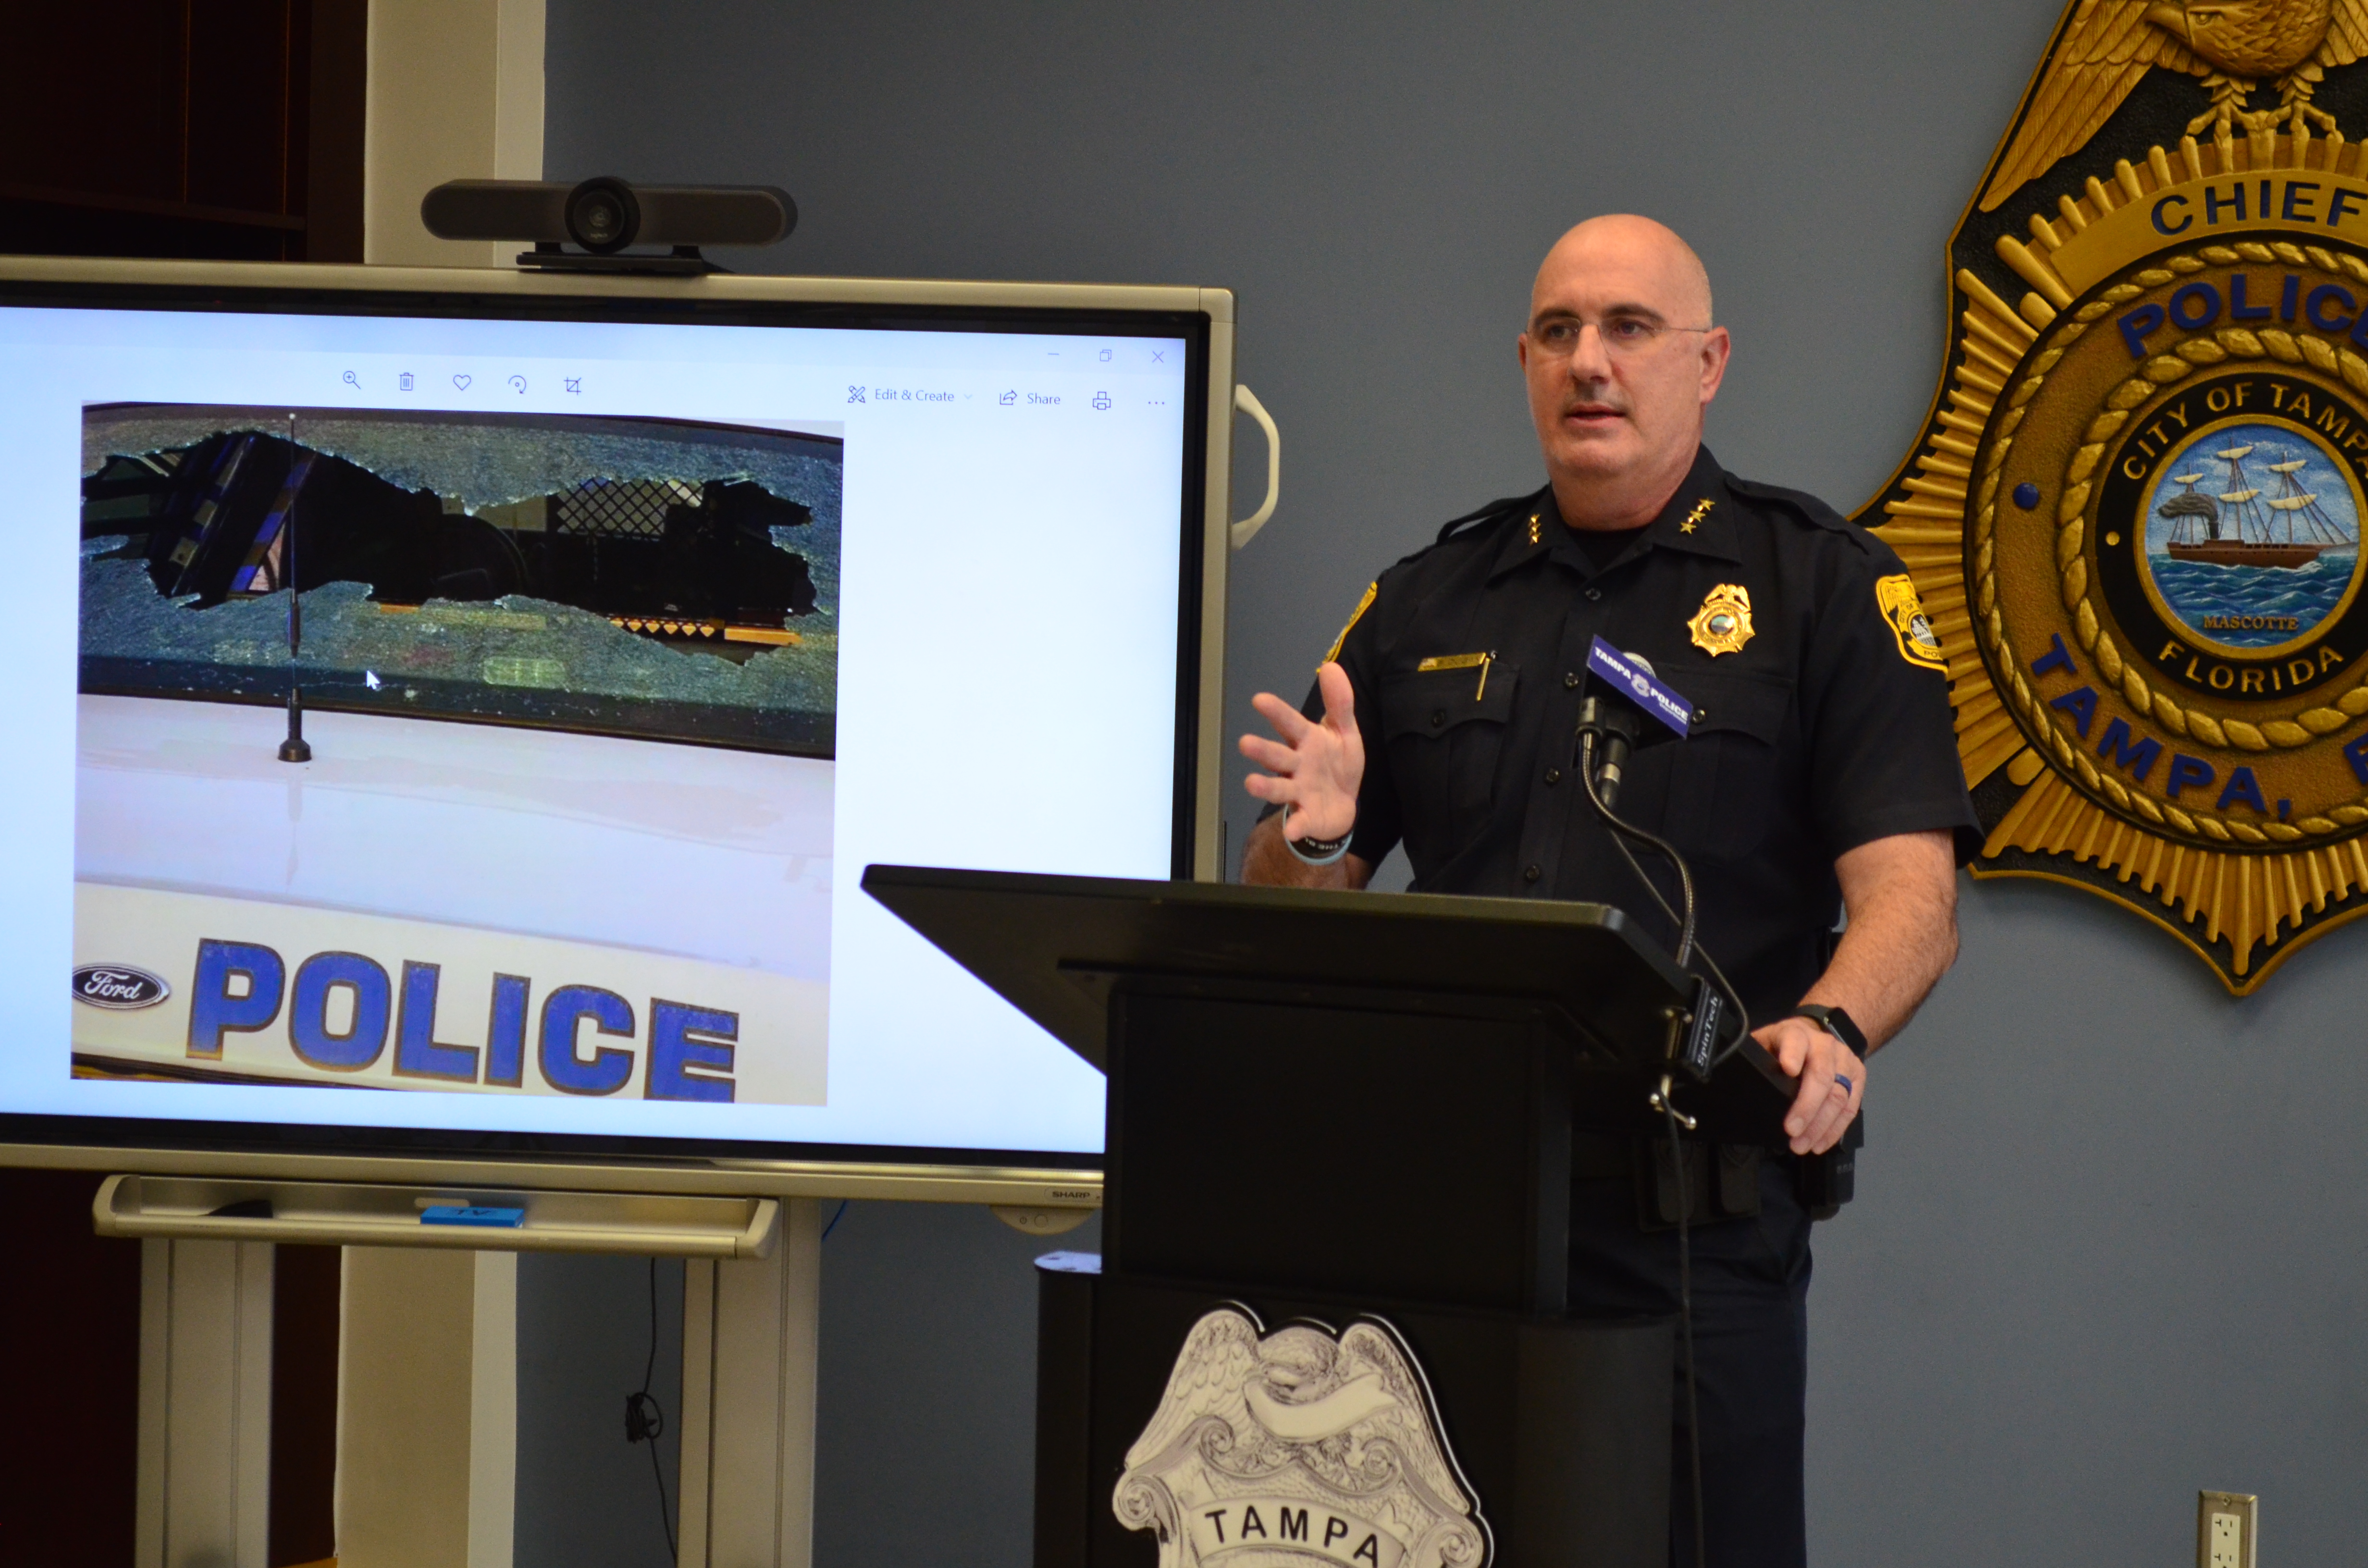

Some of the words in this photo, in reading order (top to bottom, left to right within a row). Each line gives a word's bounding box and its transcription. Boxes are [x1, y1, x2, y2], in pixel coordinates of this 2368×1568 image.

[2151, 180, 2368, 236] CHIEF
[875, 389, 898, 401] Edit
[902, 390, 912, 401] &
[916, 390, 954, 402] Create
[1027, 393, 1061, 405] Share
[2122, 402, 2190, 479] CITY
[2206, 381, 2255, 413] OF
[2203, 615, 2300, 631] MASCOTTE
[1595, 646, 1631, 680] TAMPA
[1650, 687, 1689, 720] POLICE
[2158, 640, 2344, 694] FLORIDA
[2031, 633, 2294, 820] TAMPA,
[84, 970, 143, 1000] Ford
[186, 938, 739, 1103] POLICE
[1052, 1191, 1090, 1199] SHARP
[1205, 1505, 1378, 1568] TAMPA
